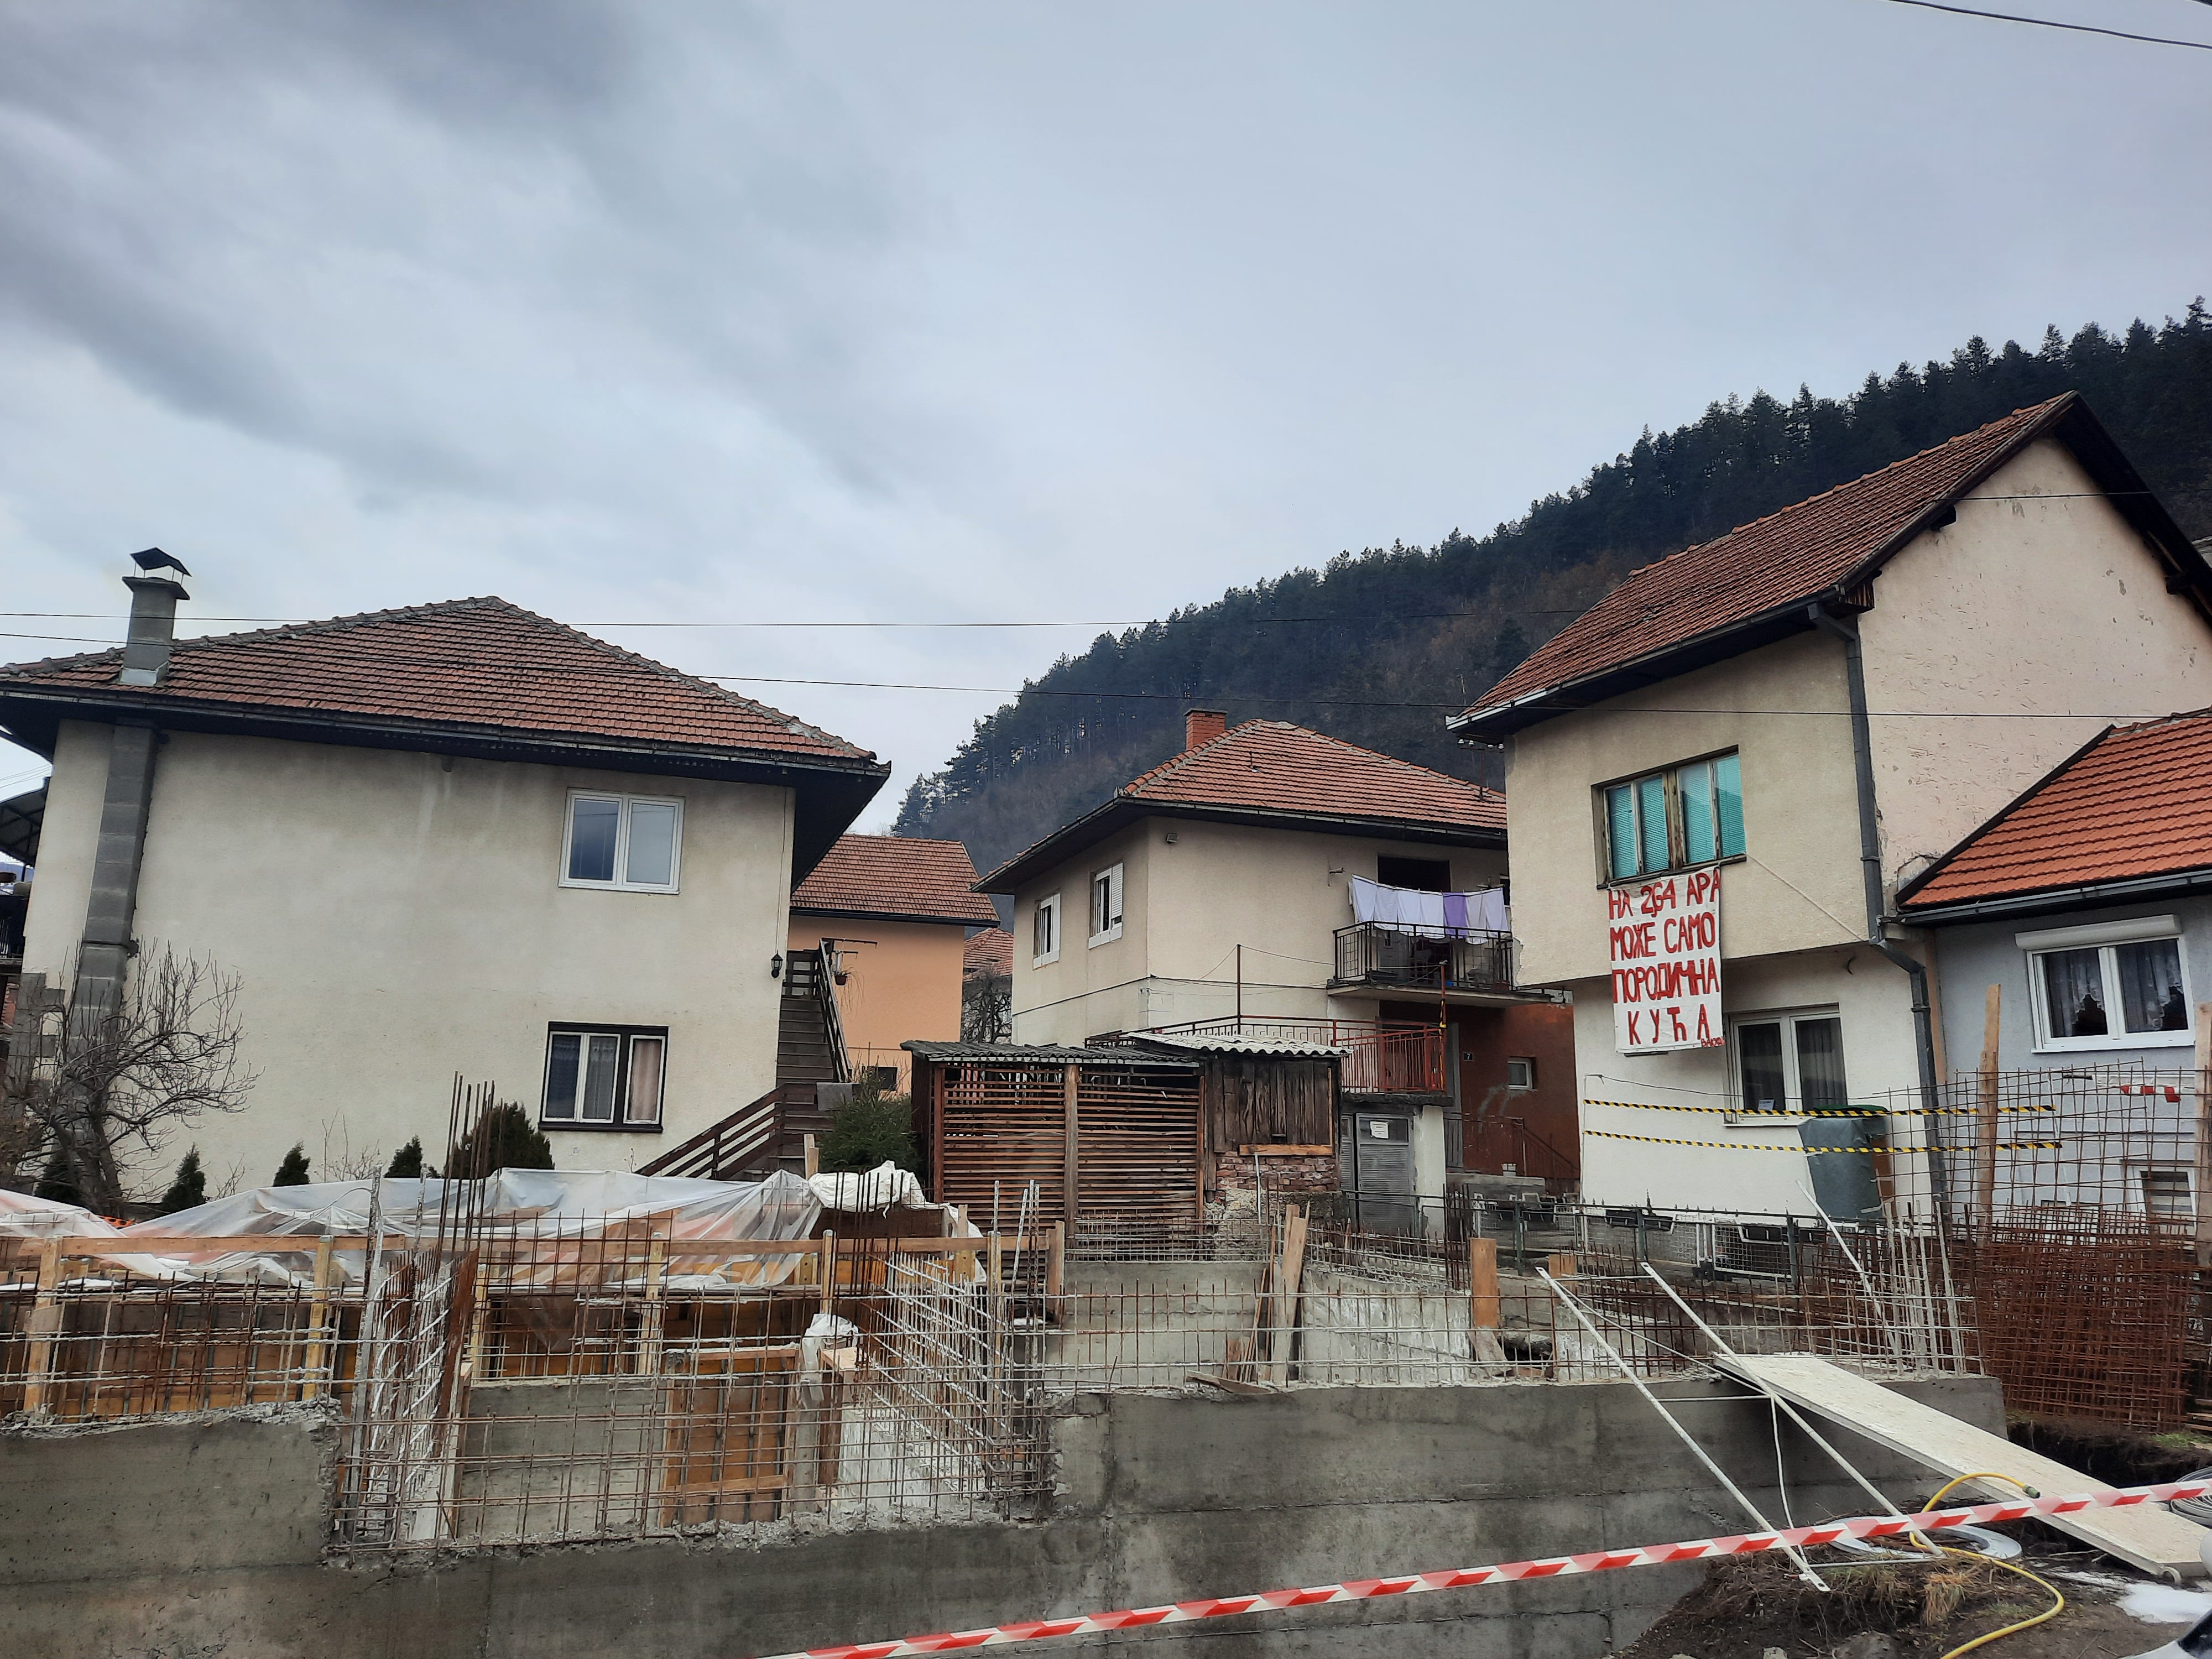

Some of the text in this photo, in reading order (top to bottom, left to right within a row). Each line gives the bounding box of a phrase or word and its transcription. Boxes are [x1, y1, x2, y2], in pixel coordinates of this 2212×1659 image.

[1609, 890, 1634, 919] НА
[1687, 869, 1720, 906] АРА
[1610, 912, 1715, 961] МОЖЕ САМО
[1613, 957, 1720, 1003] ПОРОДИЧНА
[1627, 1004, 1710, 1045] КУЋА
